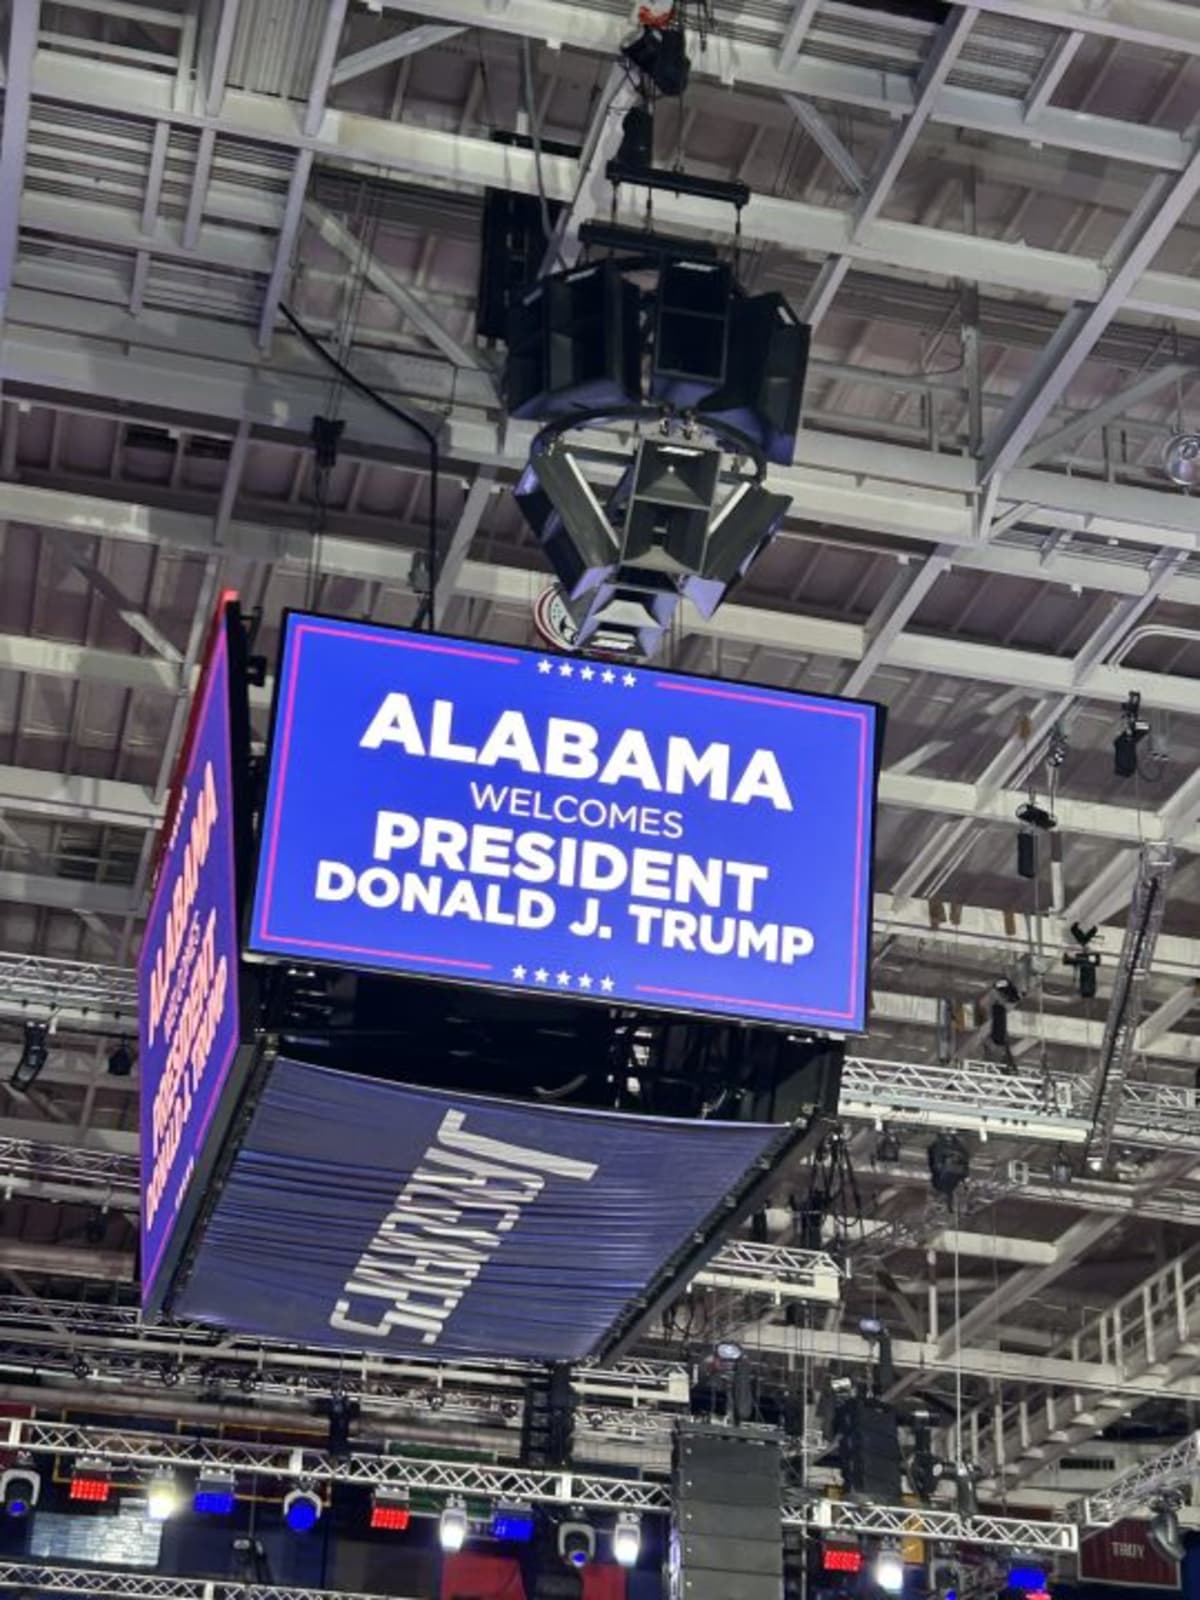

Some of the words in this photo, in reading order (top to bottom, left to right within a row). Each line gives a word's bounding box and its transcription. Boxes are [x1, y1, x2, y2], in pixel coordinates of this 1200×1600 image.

[359, 692, 794, 812] ALABAMA
[373, 810, 769, 913] PRESIDENT
[470, 781, 684, 839] WELCOMES
[314, 859, 556, 930] DONALD
[568, 897, 613, 941] J.
[627, 903, 815, 965] TRUMP
